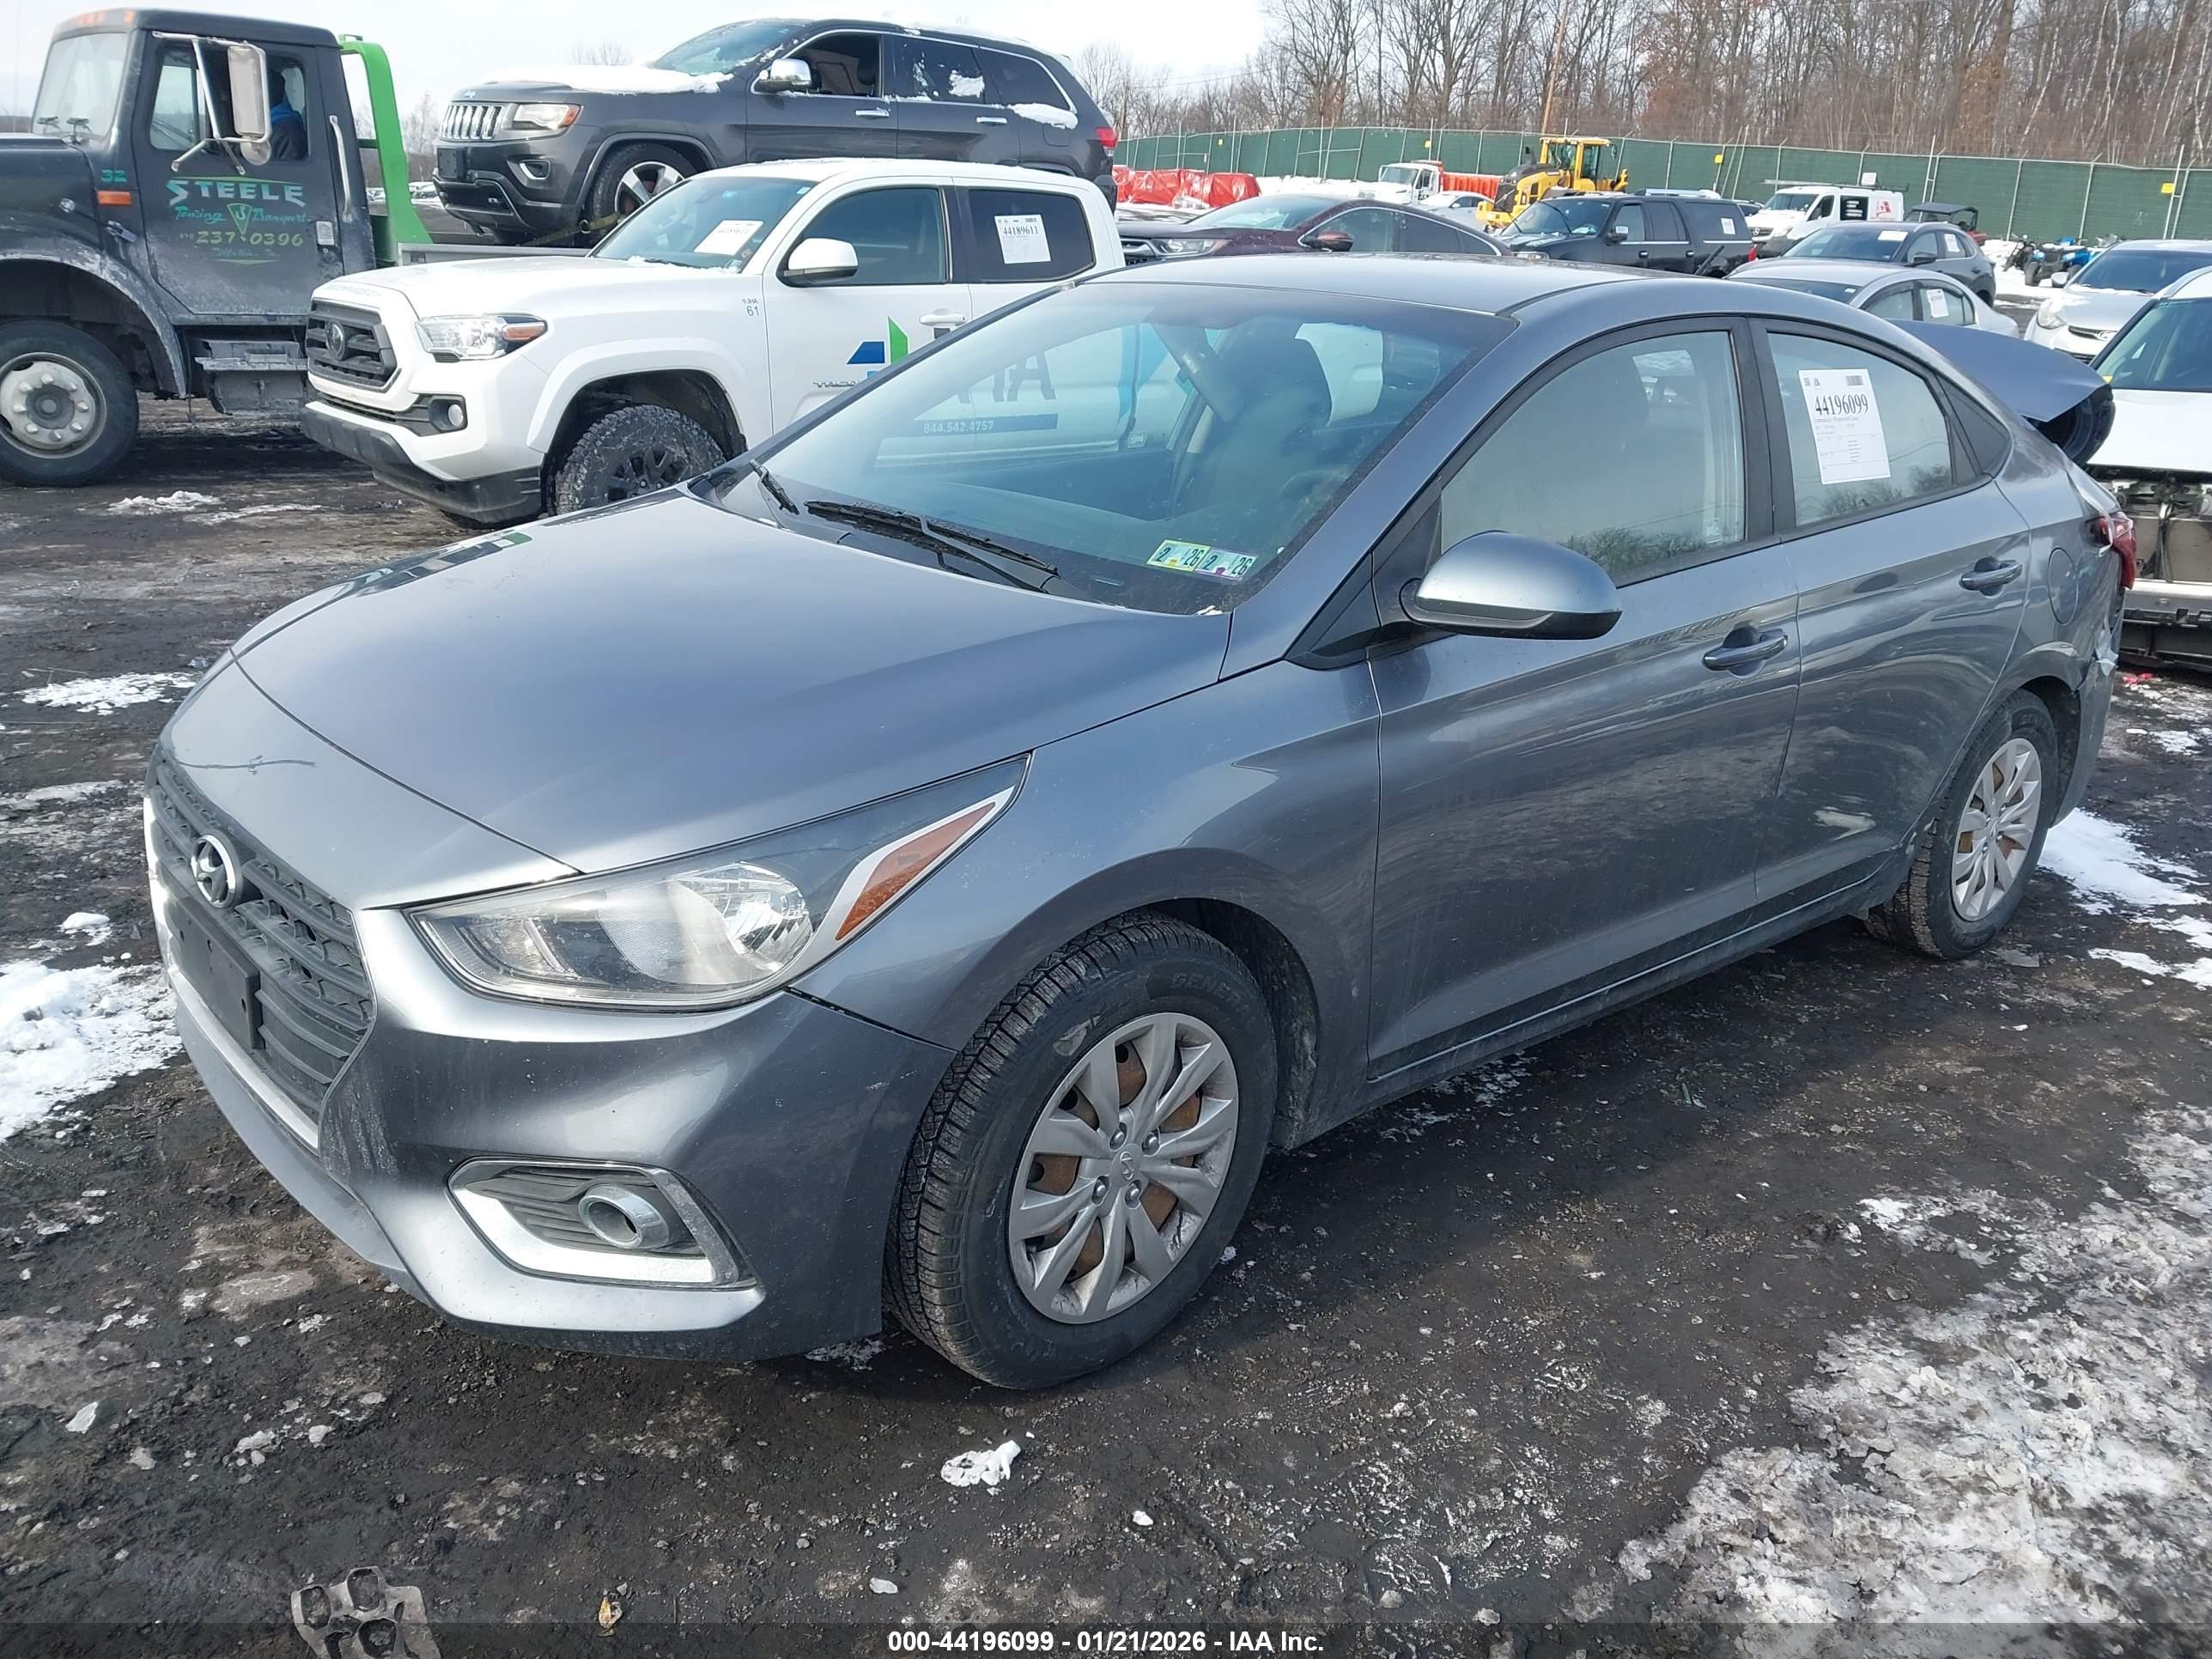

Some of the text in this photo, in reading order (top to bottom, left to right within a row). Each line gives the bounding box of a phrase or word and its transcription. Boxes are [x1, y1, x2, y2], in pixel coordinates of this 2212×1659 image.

[101, 169, 127, 183] 32
[166, 179, 307, 207] STEELE
[174, 206, 309, 225] Towing Transport
[1002, 226, 1039, 235] 44189611
[746, 306, 759, 316] 61
[1814, 394, 1869, 416] 44196099
[923, 420, 994, 434] 844.542.4757
[1155, 547, 1205, 567] 2 26
[1203, 555, 1253, 576] 2 26
